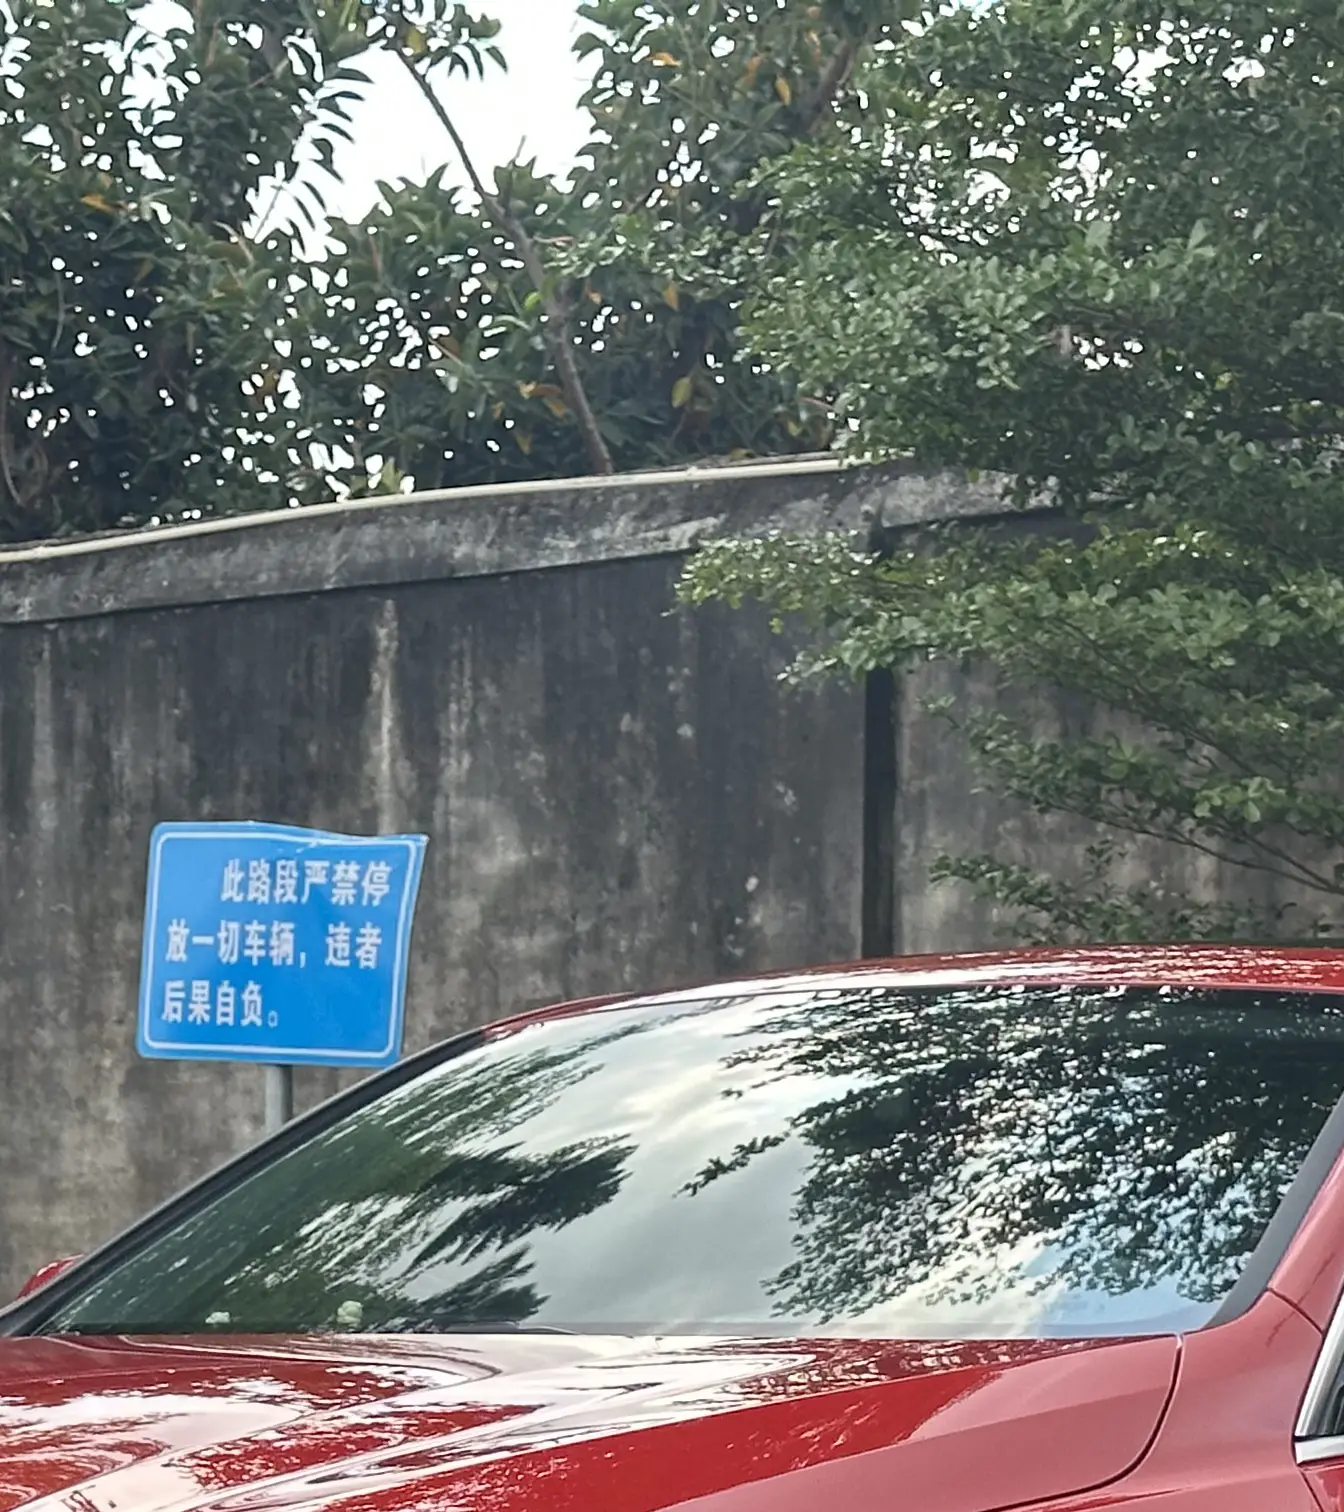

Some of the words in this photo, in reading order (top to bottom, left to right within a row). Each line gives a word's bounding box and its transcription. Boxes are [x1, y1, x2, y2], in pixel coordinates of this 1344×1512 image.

[221, 858, 392, 906] 此路段严禁停
[161, 980, 278, 1027] 后果自负。
